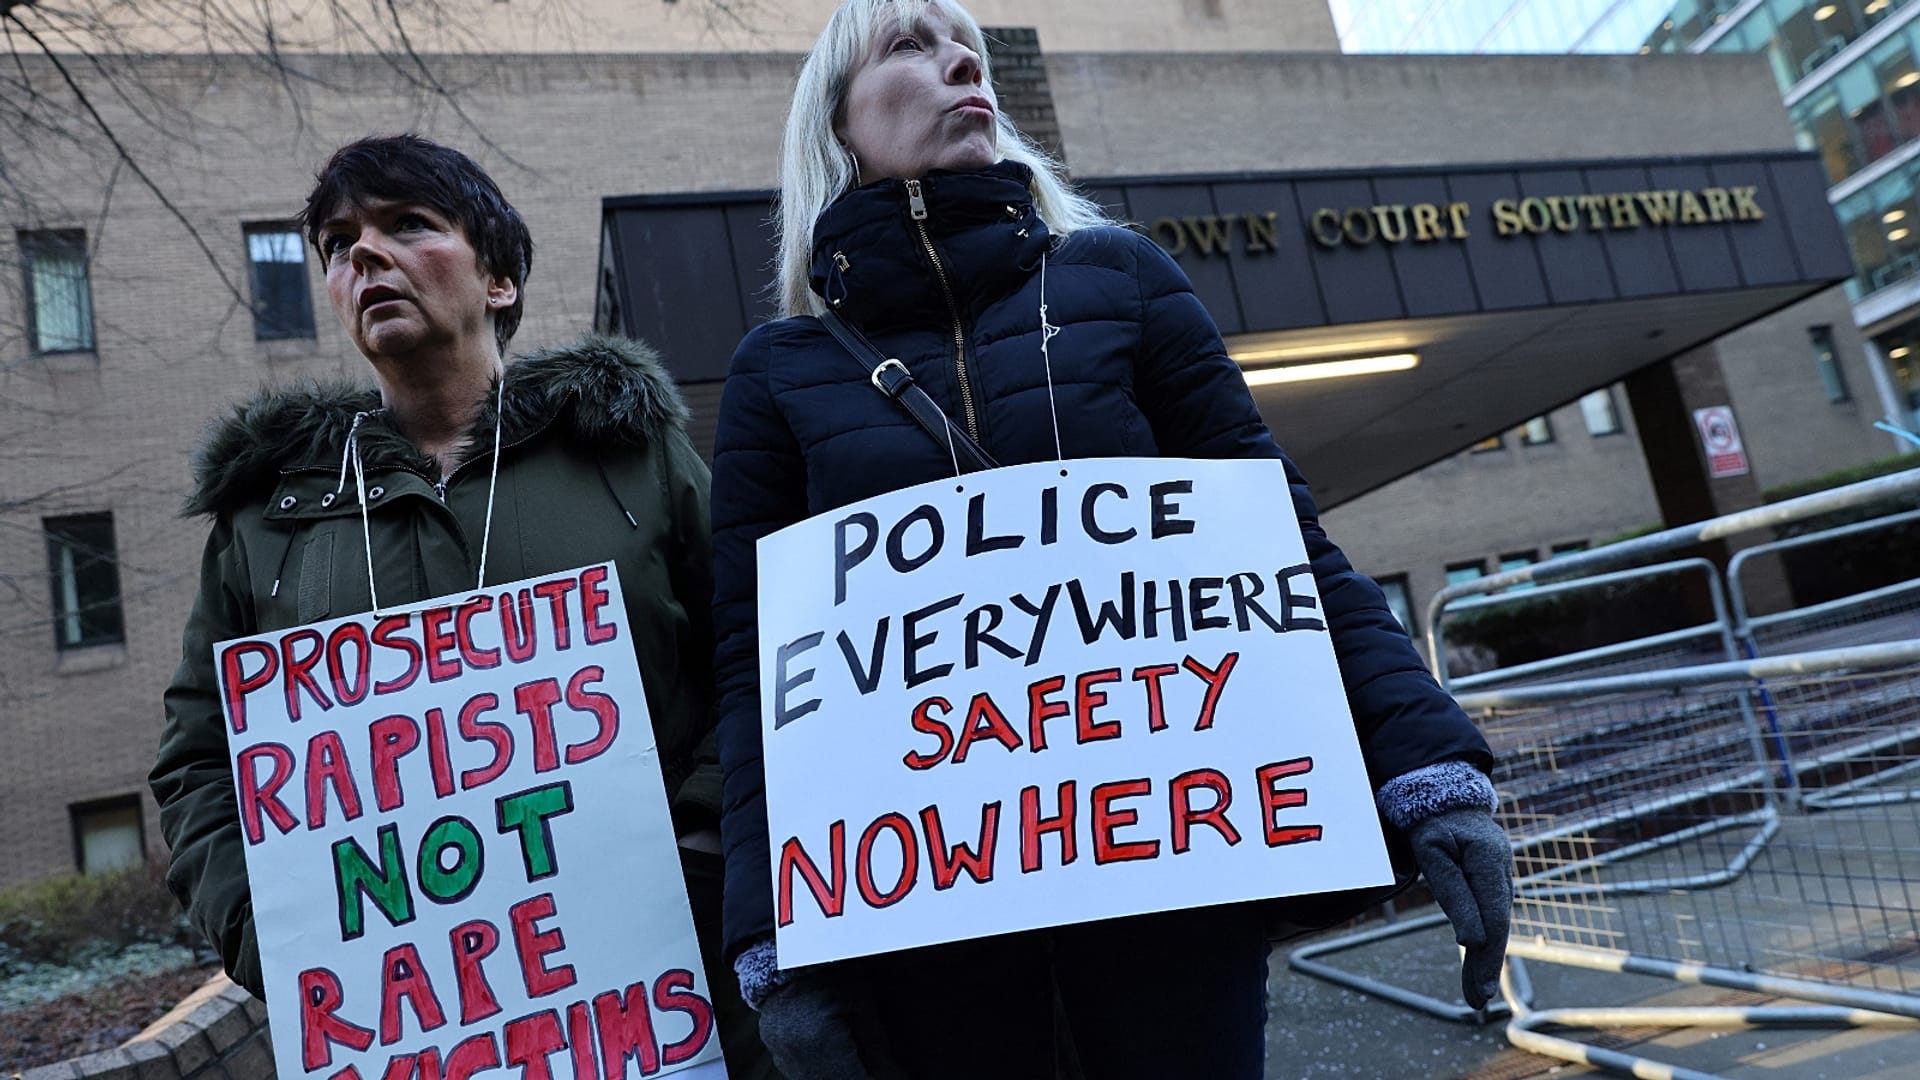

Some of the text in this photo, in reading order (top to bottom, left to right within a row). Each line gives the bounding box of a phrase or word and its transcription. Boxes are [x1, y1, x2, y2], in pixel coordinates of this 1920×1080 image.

[1142, 186, 1765, 257] OWN COURT SOUTHWARK
[834, 480, 1196, 606] POLICE
[220, 565, 618, 735] PROSECUTE
[774, 563, 1328, 731] EVERYWHERE
[903, 652, 1240, 771] SAFETY
[236, 665, 620, 845] RAPISTS
[331, 780, 574, 942] NOT
[777, 757, 1323, 928] NOWHERE
[298, 892, 578, 1073] RAPE
[328, 969, 714, 1080] CTIMS
